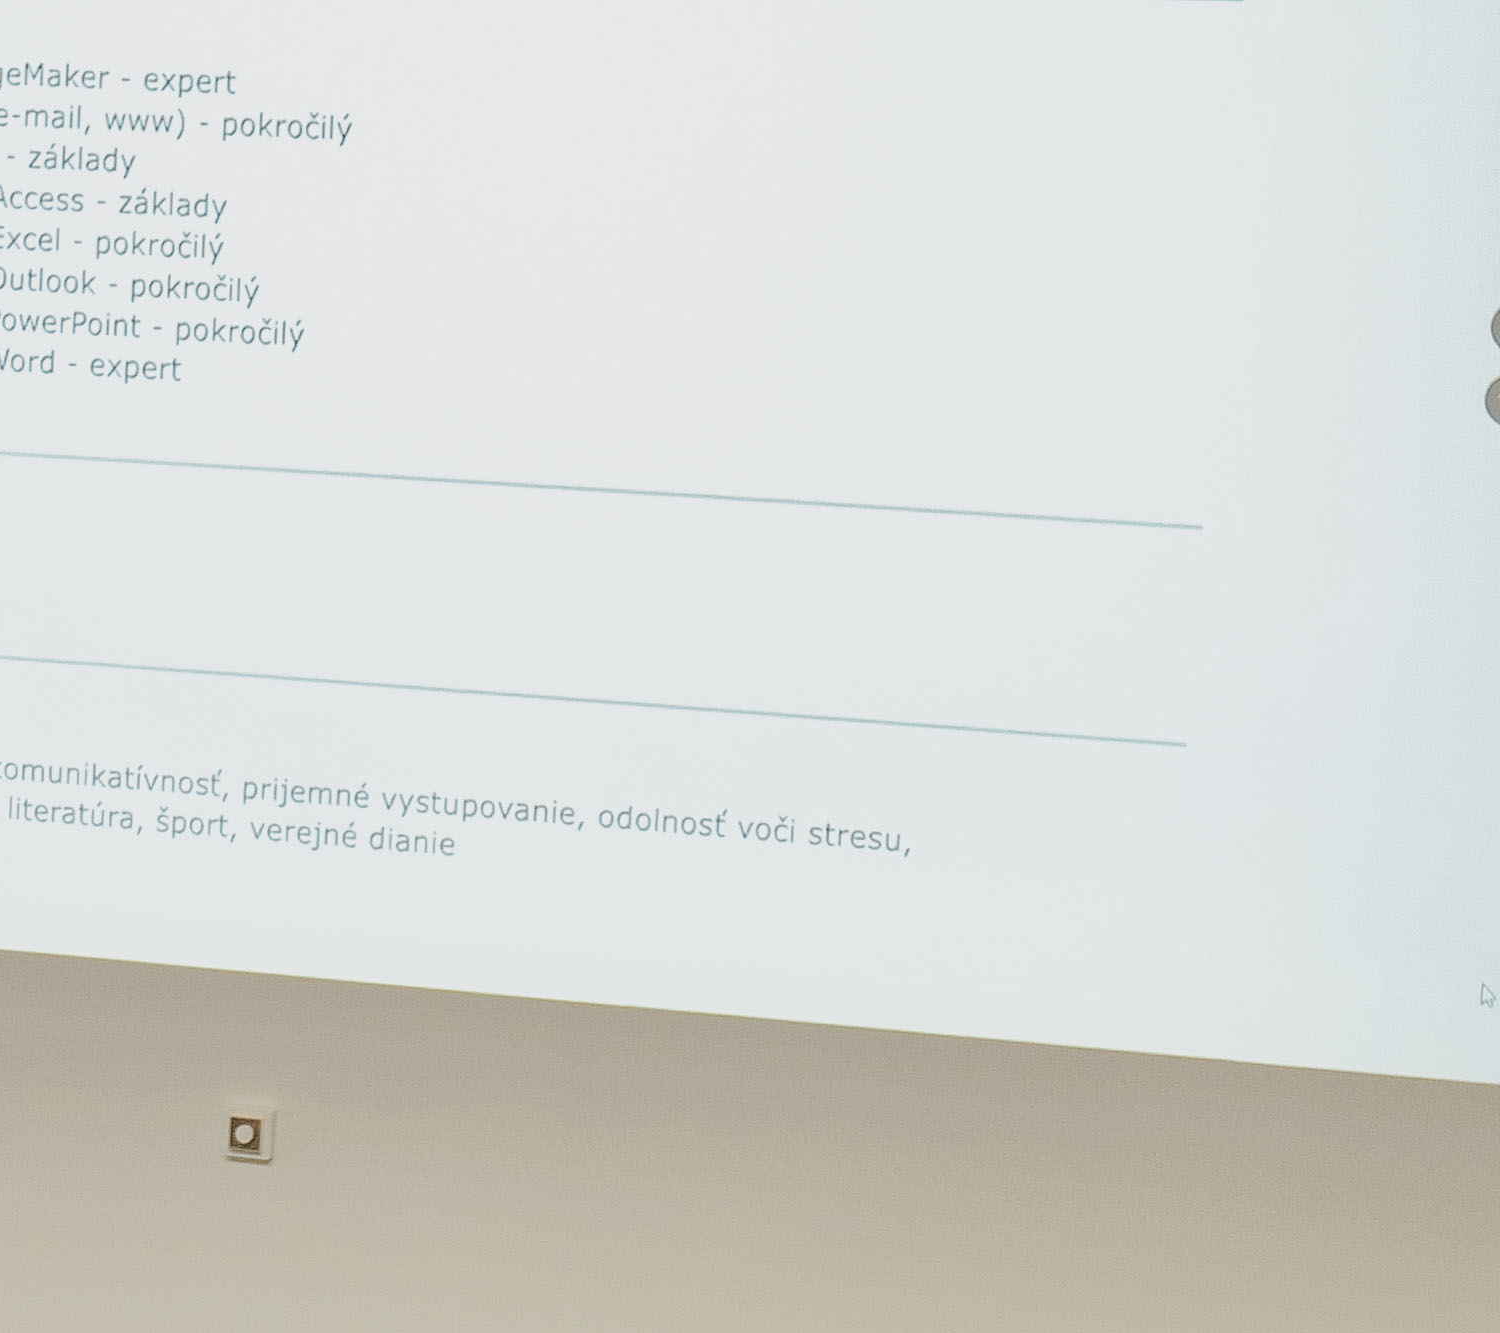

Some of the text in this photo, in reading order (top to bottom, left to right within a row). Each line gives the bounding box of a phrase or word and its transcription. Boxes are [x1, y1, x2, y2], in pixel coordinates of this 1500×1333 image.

[144, 71, 235, 97] expert
[105, 108, 184, 139] www)
[222, 112, 352, 145] pokročilý
[28, 143, 135, 178] základy
[119, 187, 226, 223] základy
[96, 231, 223, 265] pokročilý
[131, 274, 258, 308] pokročilý
[176, 317, 304, 350] pokročilý
[90, 358, 181, 383] expert
[9, 796, 142, 835] literatúra,
[156, 806, 235, 842] šport,
[250, 821, 356, 850] verejné
[369, 826, 454, 856] dianie
[243, 777, 368, 808] prijemné
[382, 792, 583, 830] vystupovanie,
[598, 806, 727, 837] odolnosť
[738, 815, 794, 842] voči
[808, 823, 909, 857] stresu,
